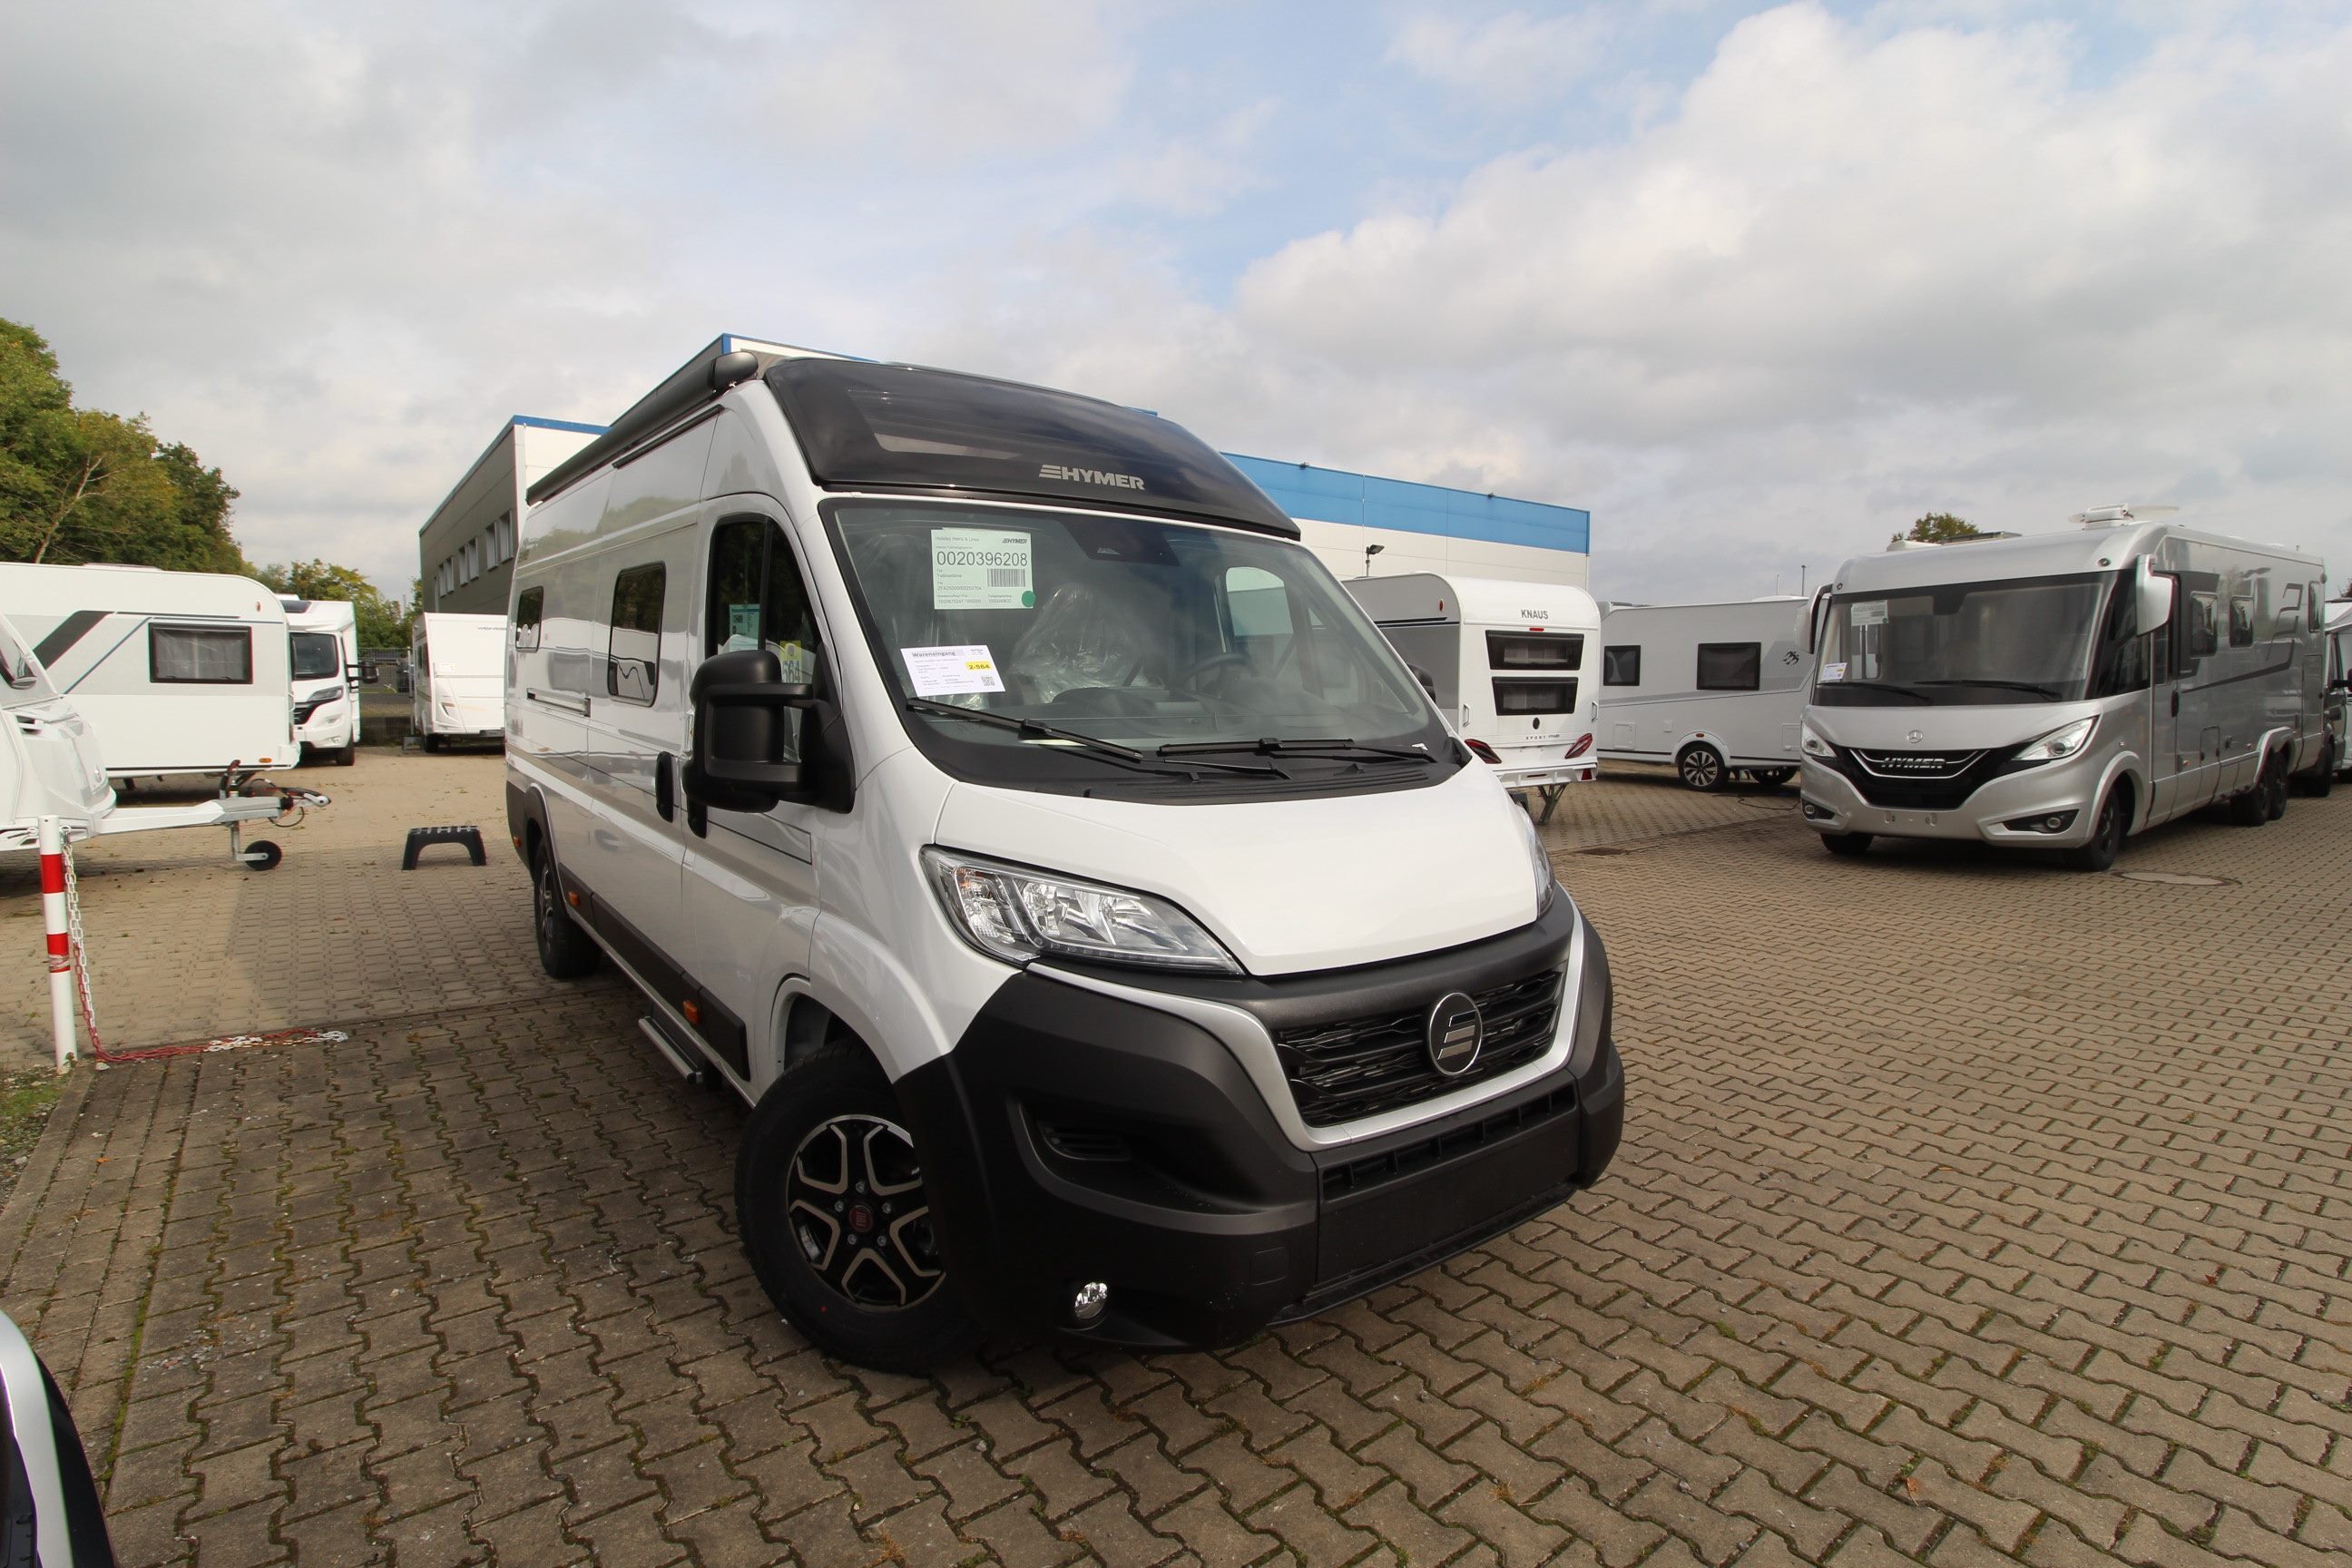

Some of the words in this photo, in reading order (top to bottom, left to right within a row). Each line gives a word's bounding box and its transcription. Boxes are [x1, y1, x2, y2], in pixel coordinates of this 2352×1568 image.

[1061, 466, 1145, 491] HYMER
[936, 551, 1028, 567] 0020396208
[1521, 610, 1549, 620] KNAUS
[1881, 758, 1945, 769] HYMER
